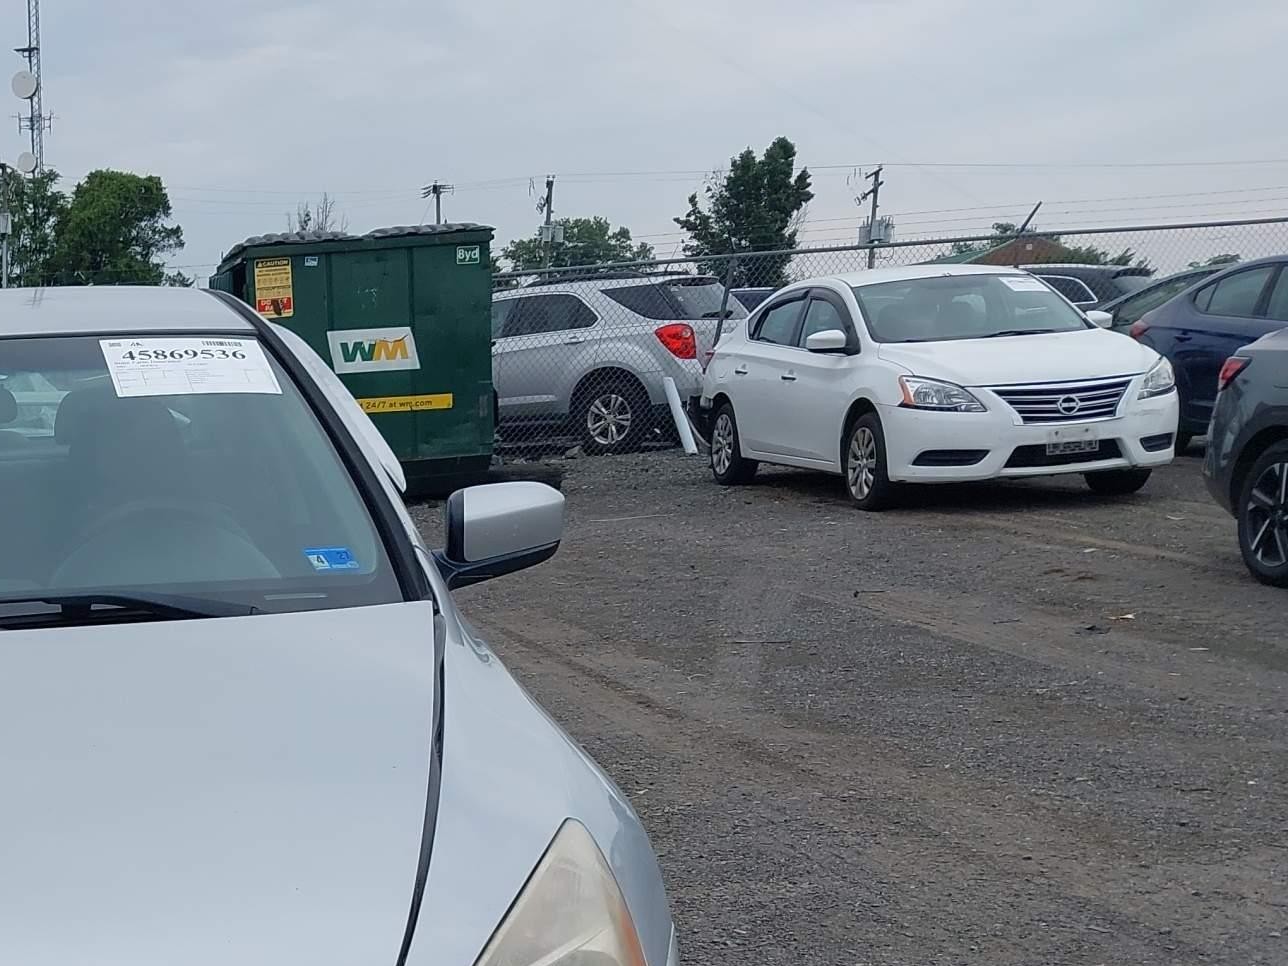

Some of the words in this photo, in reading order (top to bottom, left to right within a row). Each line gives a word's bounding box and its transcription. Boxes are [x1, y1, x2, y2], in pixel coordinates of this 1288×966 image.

[458, 247, 479, 261] 8yd
[122, 348, 247, 361] 45869536
[340, 338, 409, 363] WM
[365, 400, 387, 409] 24/7
